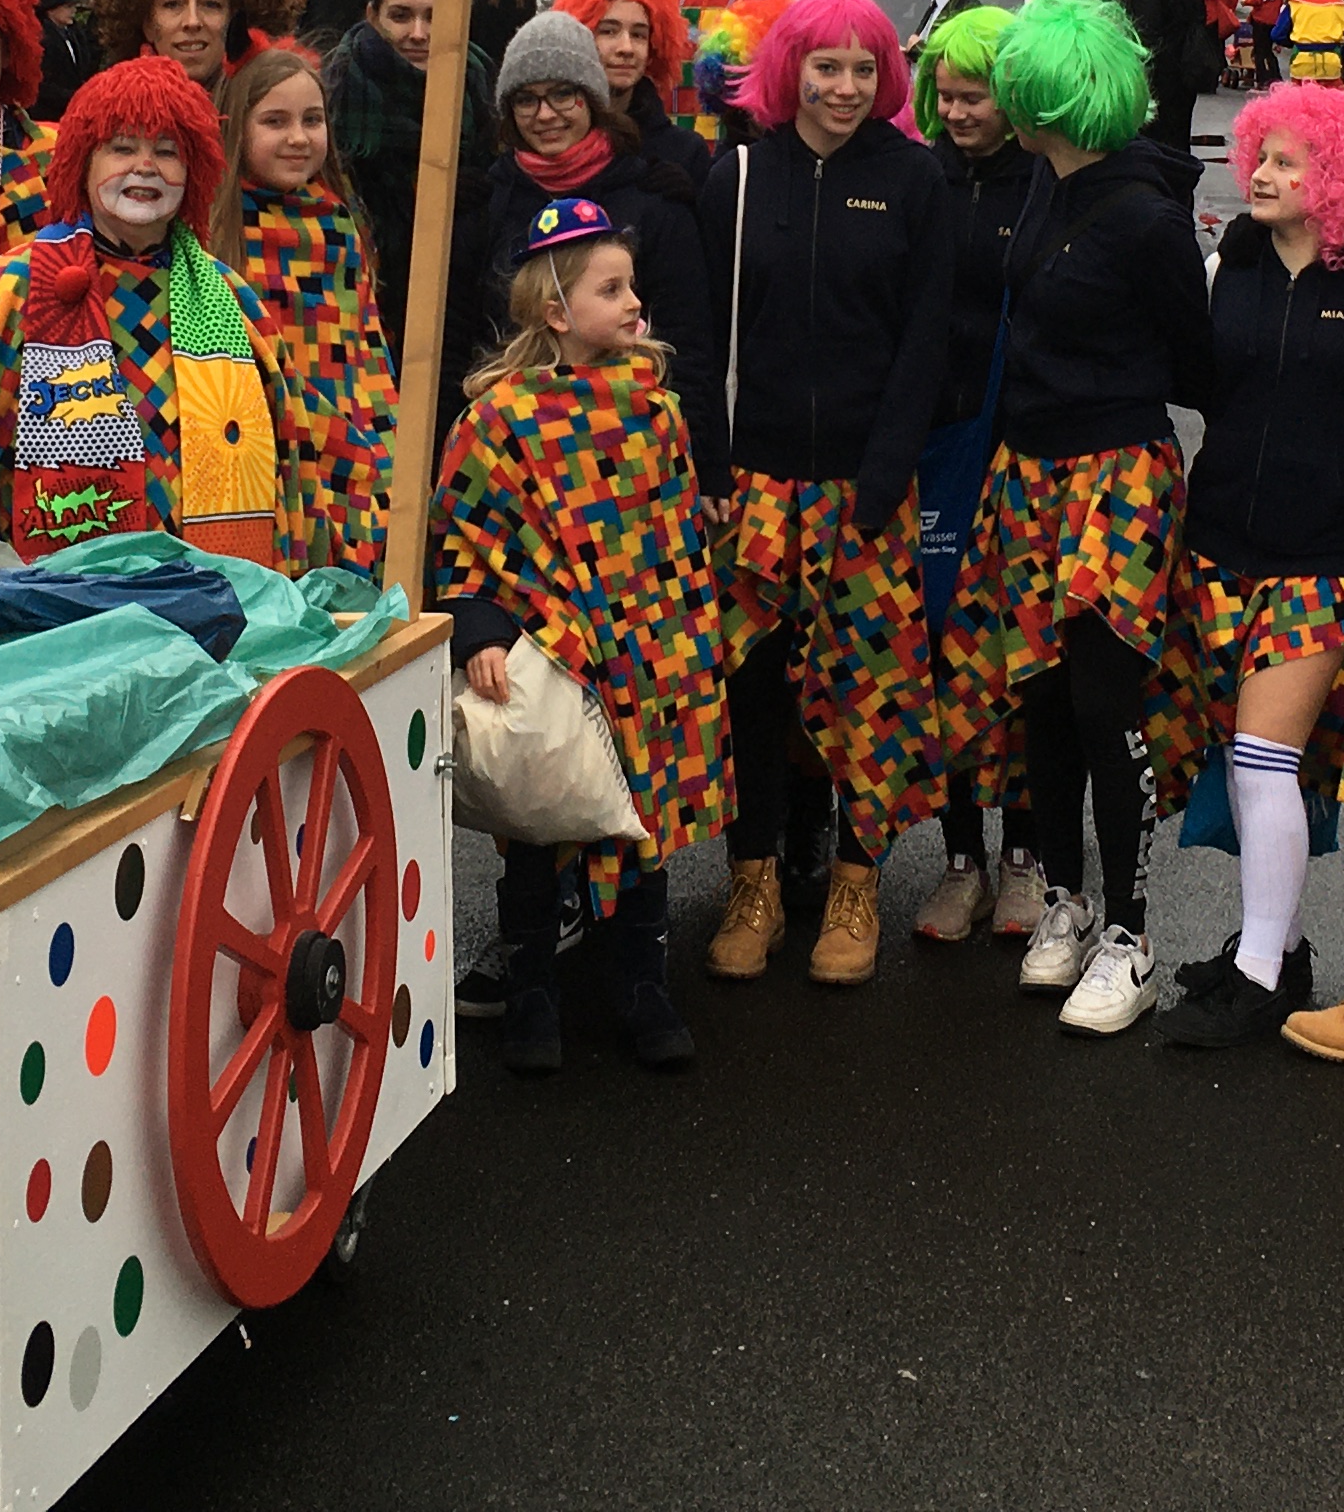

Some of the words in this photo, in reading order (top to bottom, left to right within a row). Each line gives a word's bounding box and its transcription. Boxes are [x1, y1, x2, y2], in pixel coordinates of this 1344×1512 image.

[846, 198, 887, 211] CARINA
[1320, 310, 1344, 320] MIA
[22, 499, 112, 533] ALAAF
